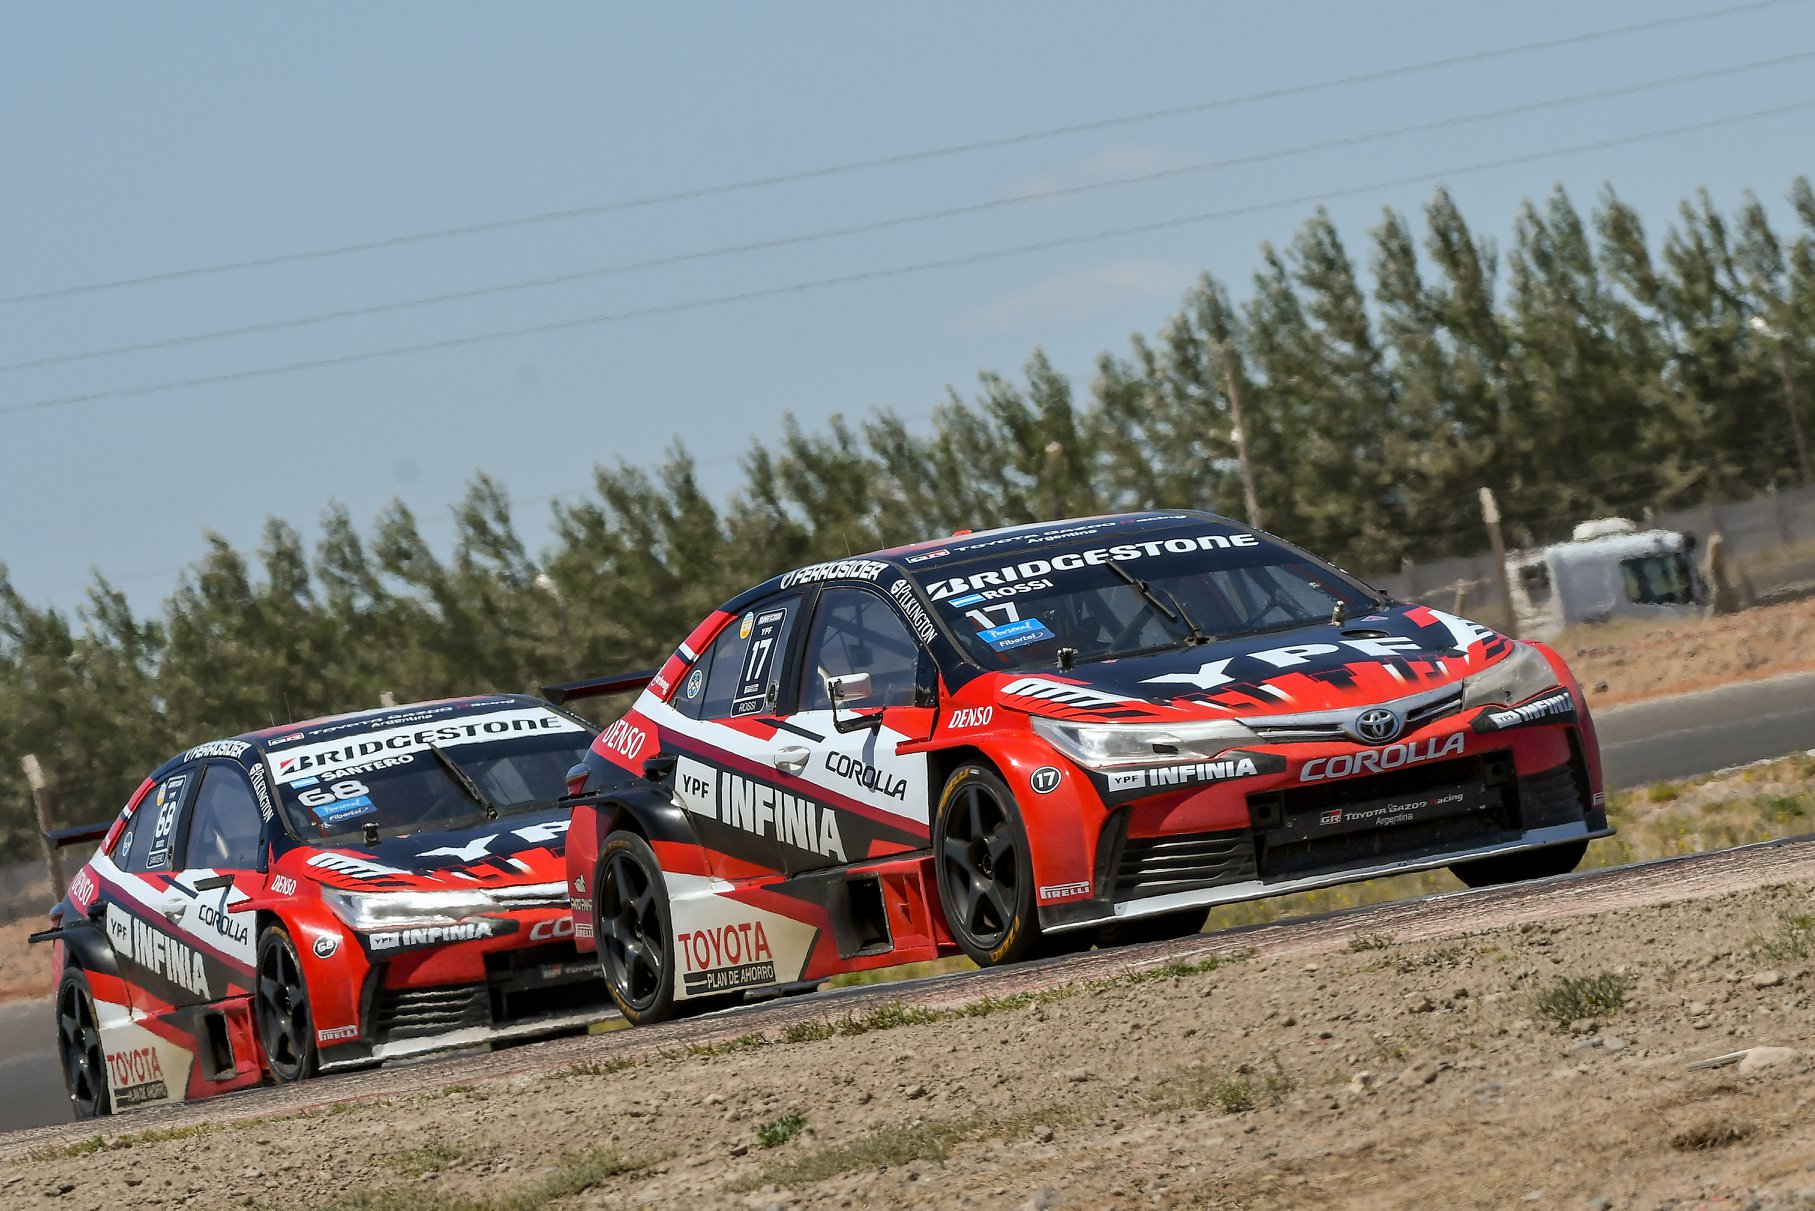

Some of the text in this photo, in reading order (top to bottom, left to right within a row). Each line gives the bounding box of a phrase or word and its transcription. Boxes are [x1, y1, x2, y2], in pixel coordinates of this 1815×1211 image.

[953, 533, 1039, 552] TOYOTA
[1027, 529, 1098, 544] Argentina
[925, 533, 1260, 601] BRIDGESTONE
[981, 578, 1055, 600] ROSSI
[896, 584, 938, 645] PILKINGTON
[965, 602, 1020, 629] 17
[745, 638, 774, 682] 17
[1137, 636, 1422, 690] YPF
[948, 705, 993, 729] DENSO
[279, 716, 562, 776] BRIDGESTONE
[602, 719, 646, 760] DENSO
[321, 754, 414, 781] SANTERO
[1114, 757, 1258, 787] YPF INFINIA
[1299, 732, 1465, 782] COROLLA
[825, 750, 908, 801] COROLLA
[1036, 771, 1055, 789] 17
[298, 780, 370, 807] 68
[1320, 793, 1464, 824] GR TOYOTA GAZOO Racing
[155, 801, 177, 838] 68
[682, 771, 847, 863] YPF INFINIA
[1375, 812, 1414, 827] Argentina
[271, 874, 297, 897] DENSO
[1039, 881, 1090, 900] PIRELLI
[198, 904, 248, 946] COROLLA
[402, 921, 493, 946] INFINIA
[110, 917, 211, 1001] YPF INFINIA
[678, 921, 772, 971] TOYOTA
[707, 965, 774, 989] PLAN DE AHORRO
[106, 1047, 164, 1087] TOYOTA
